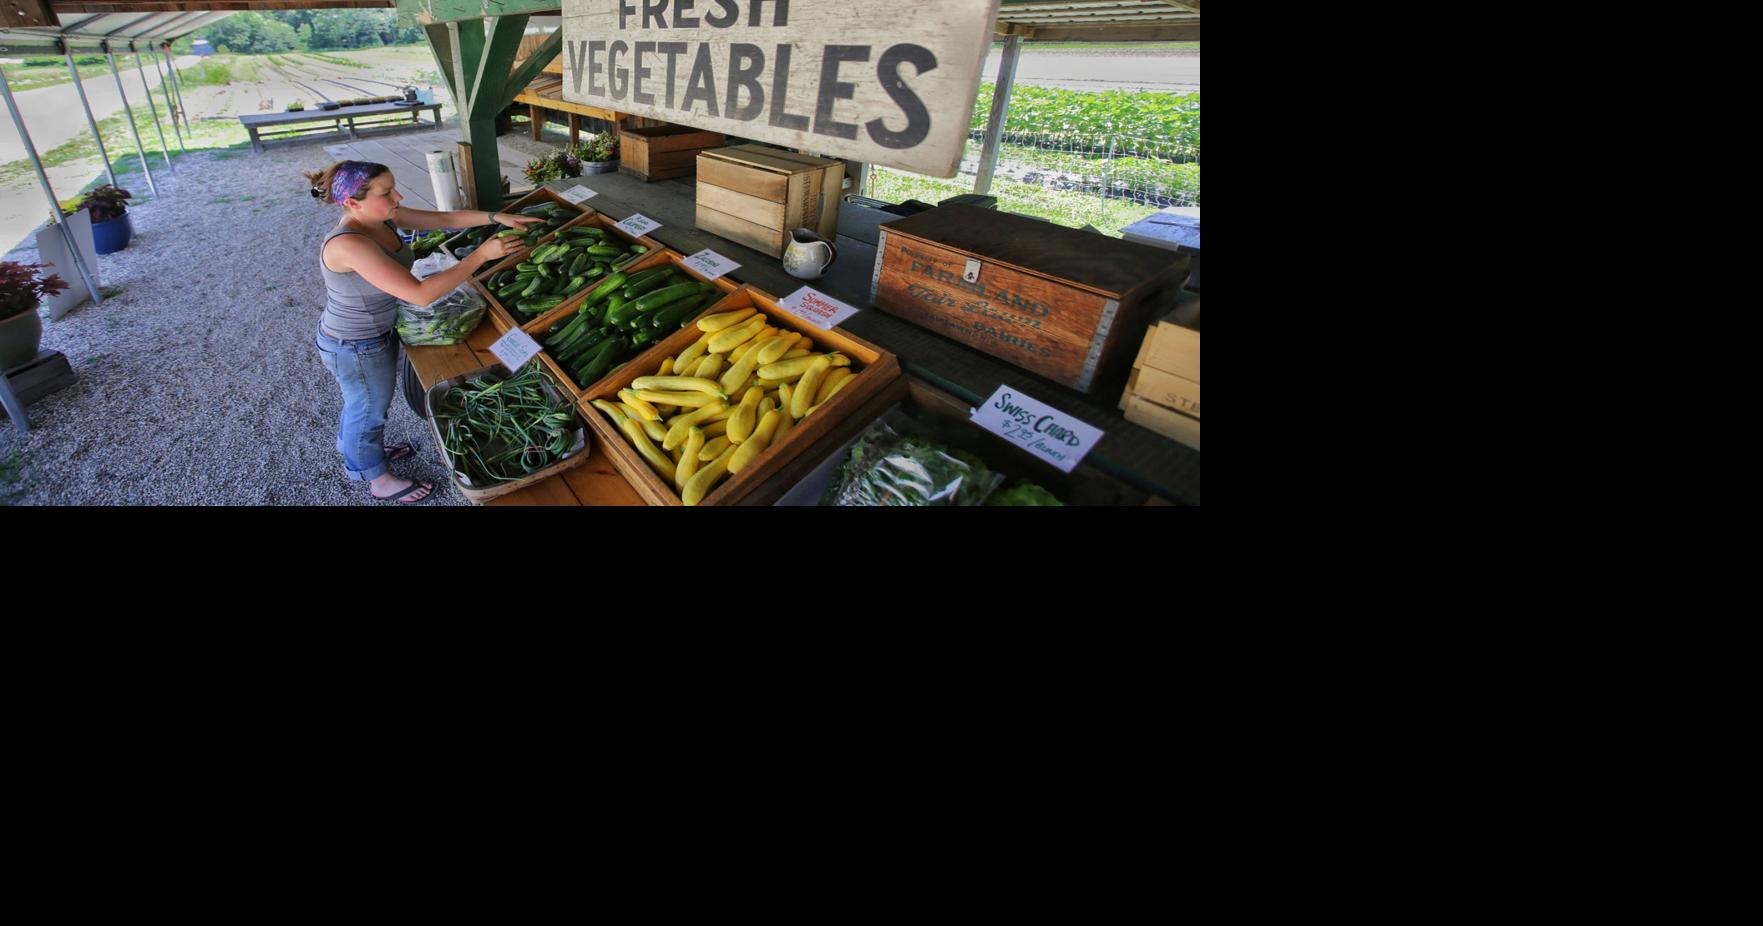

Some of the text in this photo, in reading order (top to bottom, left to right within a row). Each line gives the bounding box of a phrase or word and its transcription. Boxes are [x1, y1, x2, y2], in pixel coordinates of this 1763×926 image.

[619, 0, 789, 29] FRESH
[568, 40, 938, 149] VEGETABLES
[994, 392, 1081, 447] SWISS CHARD
